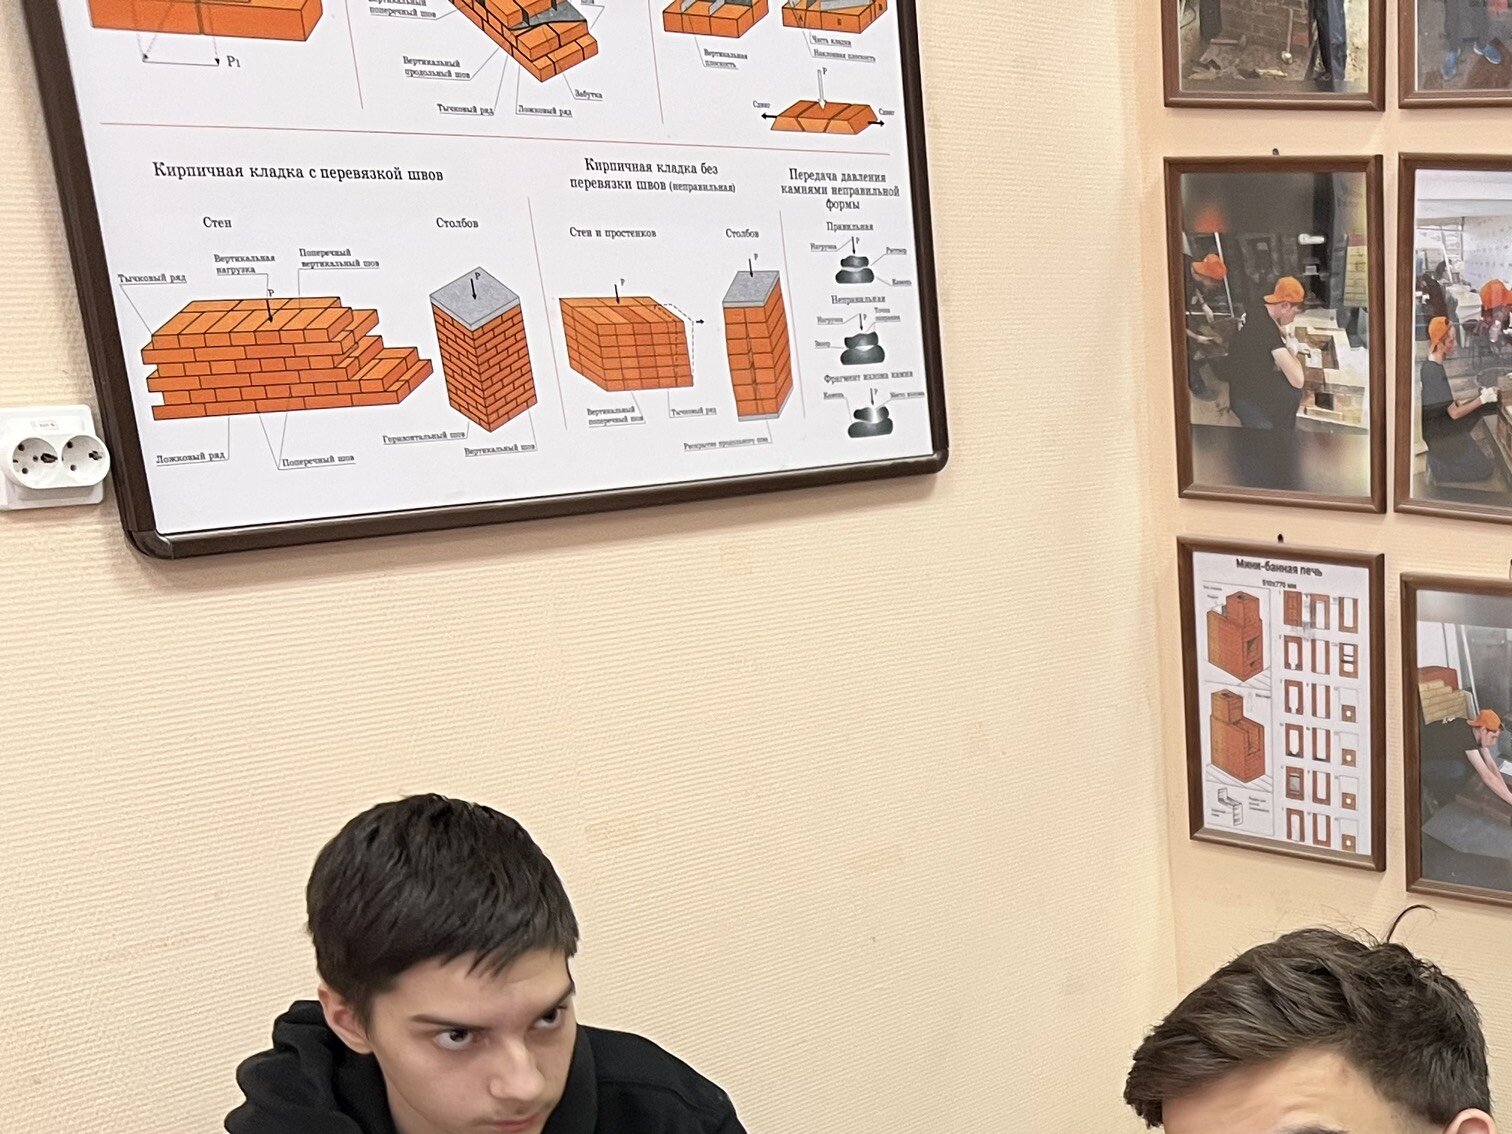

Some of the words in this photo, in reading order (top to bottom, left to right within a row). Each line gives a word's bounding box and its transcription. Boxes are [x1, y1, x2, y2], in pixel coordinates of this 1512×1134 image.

[152, 161, 244, 180] Кирпичная
[250, 166, 304, 181] кладка
[309, 168, 317, 179] с
[320, 167, 402, 183] перевязкой
[407, 170, 444, 182] швов
[584, 157, 652, 174] Кирпичная
[657, 163, 697, 175] кладка
[700, 162, 718, 175] без
[789, 168, 837, 182] Передача
[841, 172, 886, 182] давления
[569, 177, 632, 190] перевязки
[636, 180, 667, 191] швов
[781, 185, 828, 196] камнями
[831, 186, 900, 198] неправильной
[826, 199, 860, 211] формы
[203, 216, 232, 228] Стен
[436, 217, 479, 229] Столбов
[605, 228, 657, 239] простенков
[725, 228, 760, 239] Столбов
[156, 451, 205, 464] Ложковый
[1236, 559, 1298, 574] Мини-банная
[1300, 566, 1323, 577] печь
